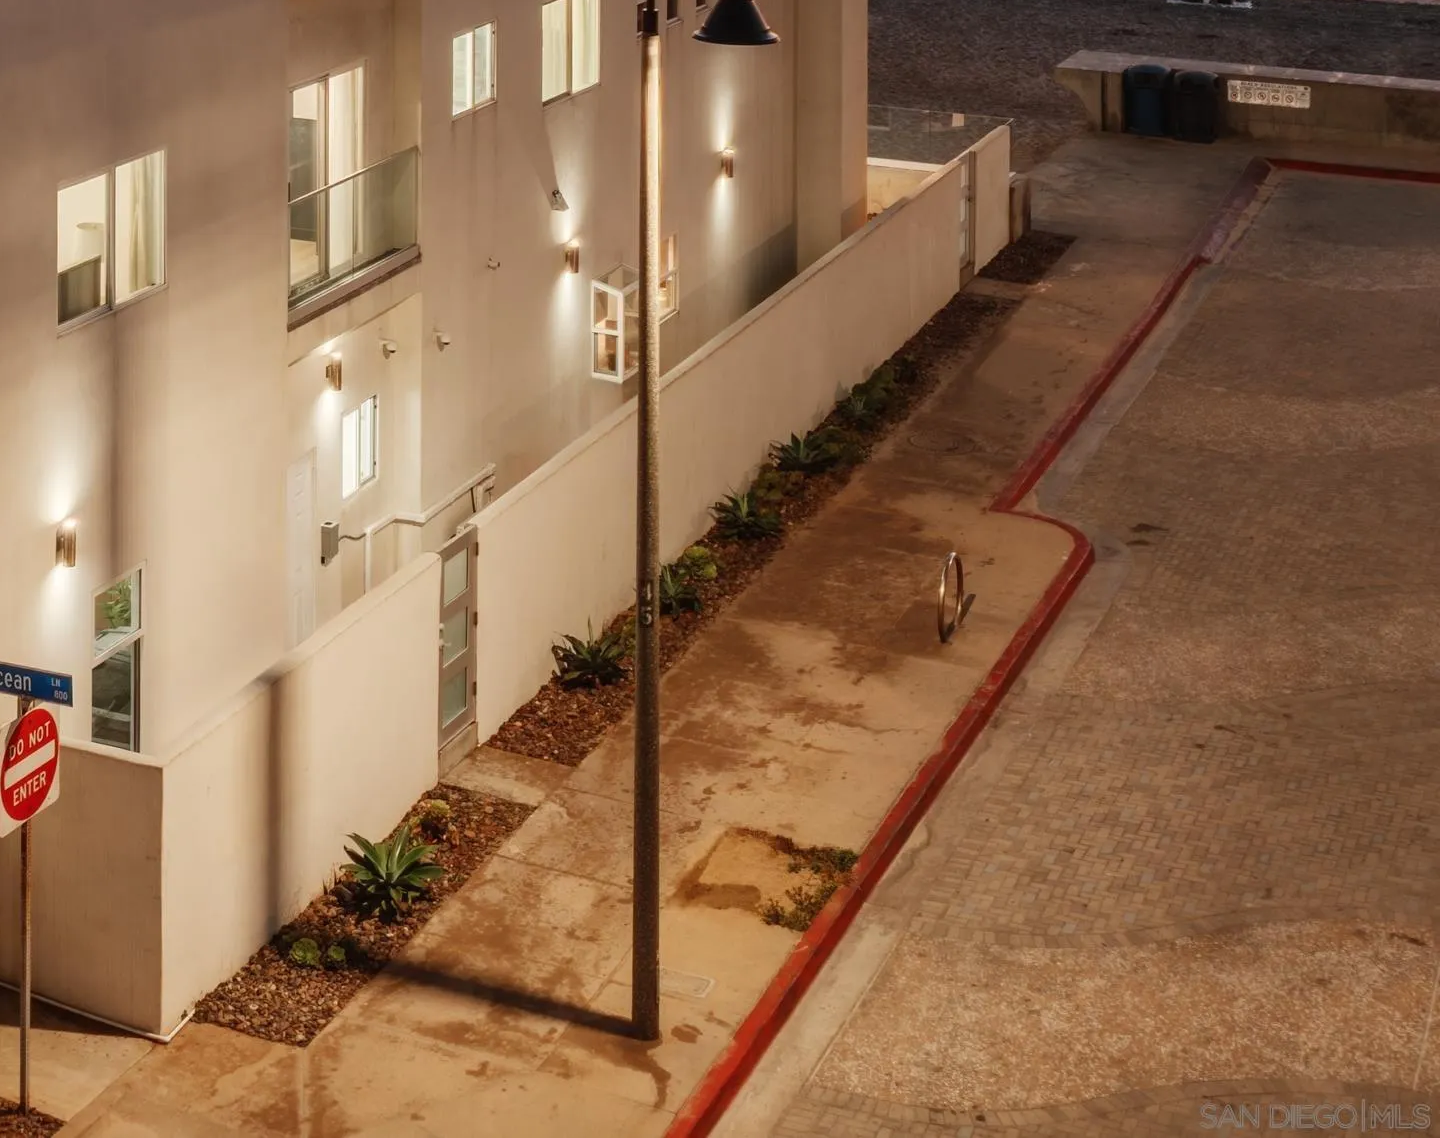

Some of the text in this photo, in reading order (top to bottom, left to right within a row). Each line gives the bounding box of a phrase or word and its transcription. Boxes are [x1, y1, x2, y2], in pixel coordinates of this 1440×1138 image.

[51, 677, 61, 687] LN
[10, 720, 51, 761] DO NOT
[13, 770, 47, 807] ENTER
